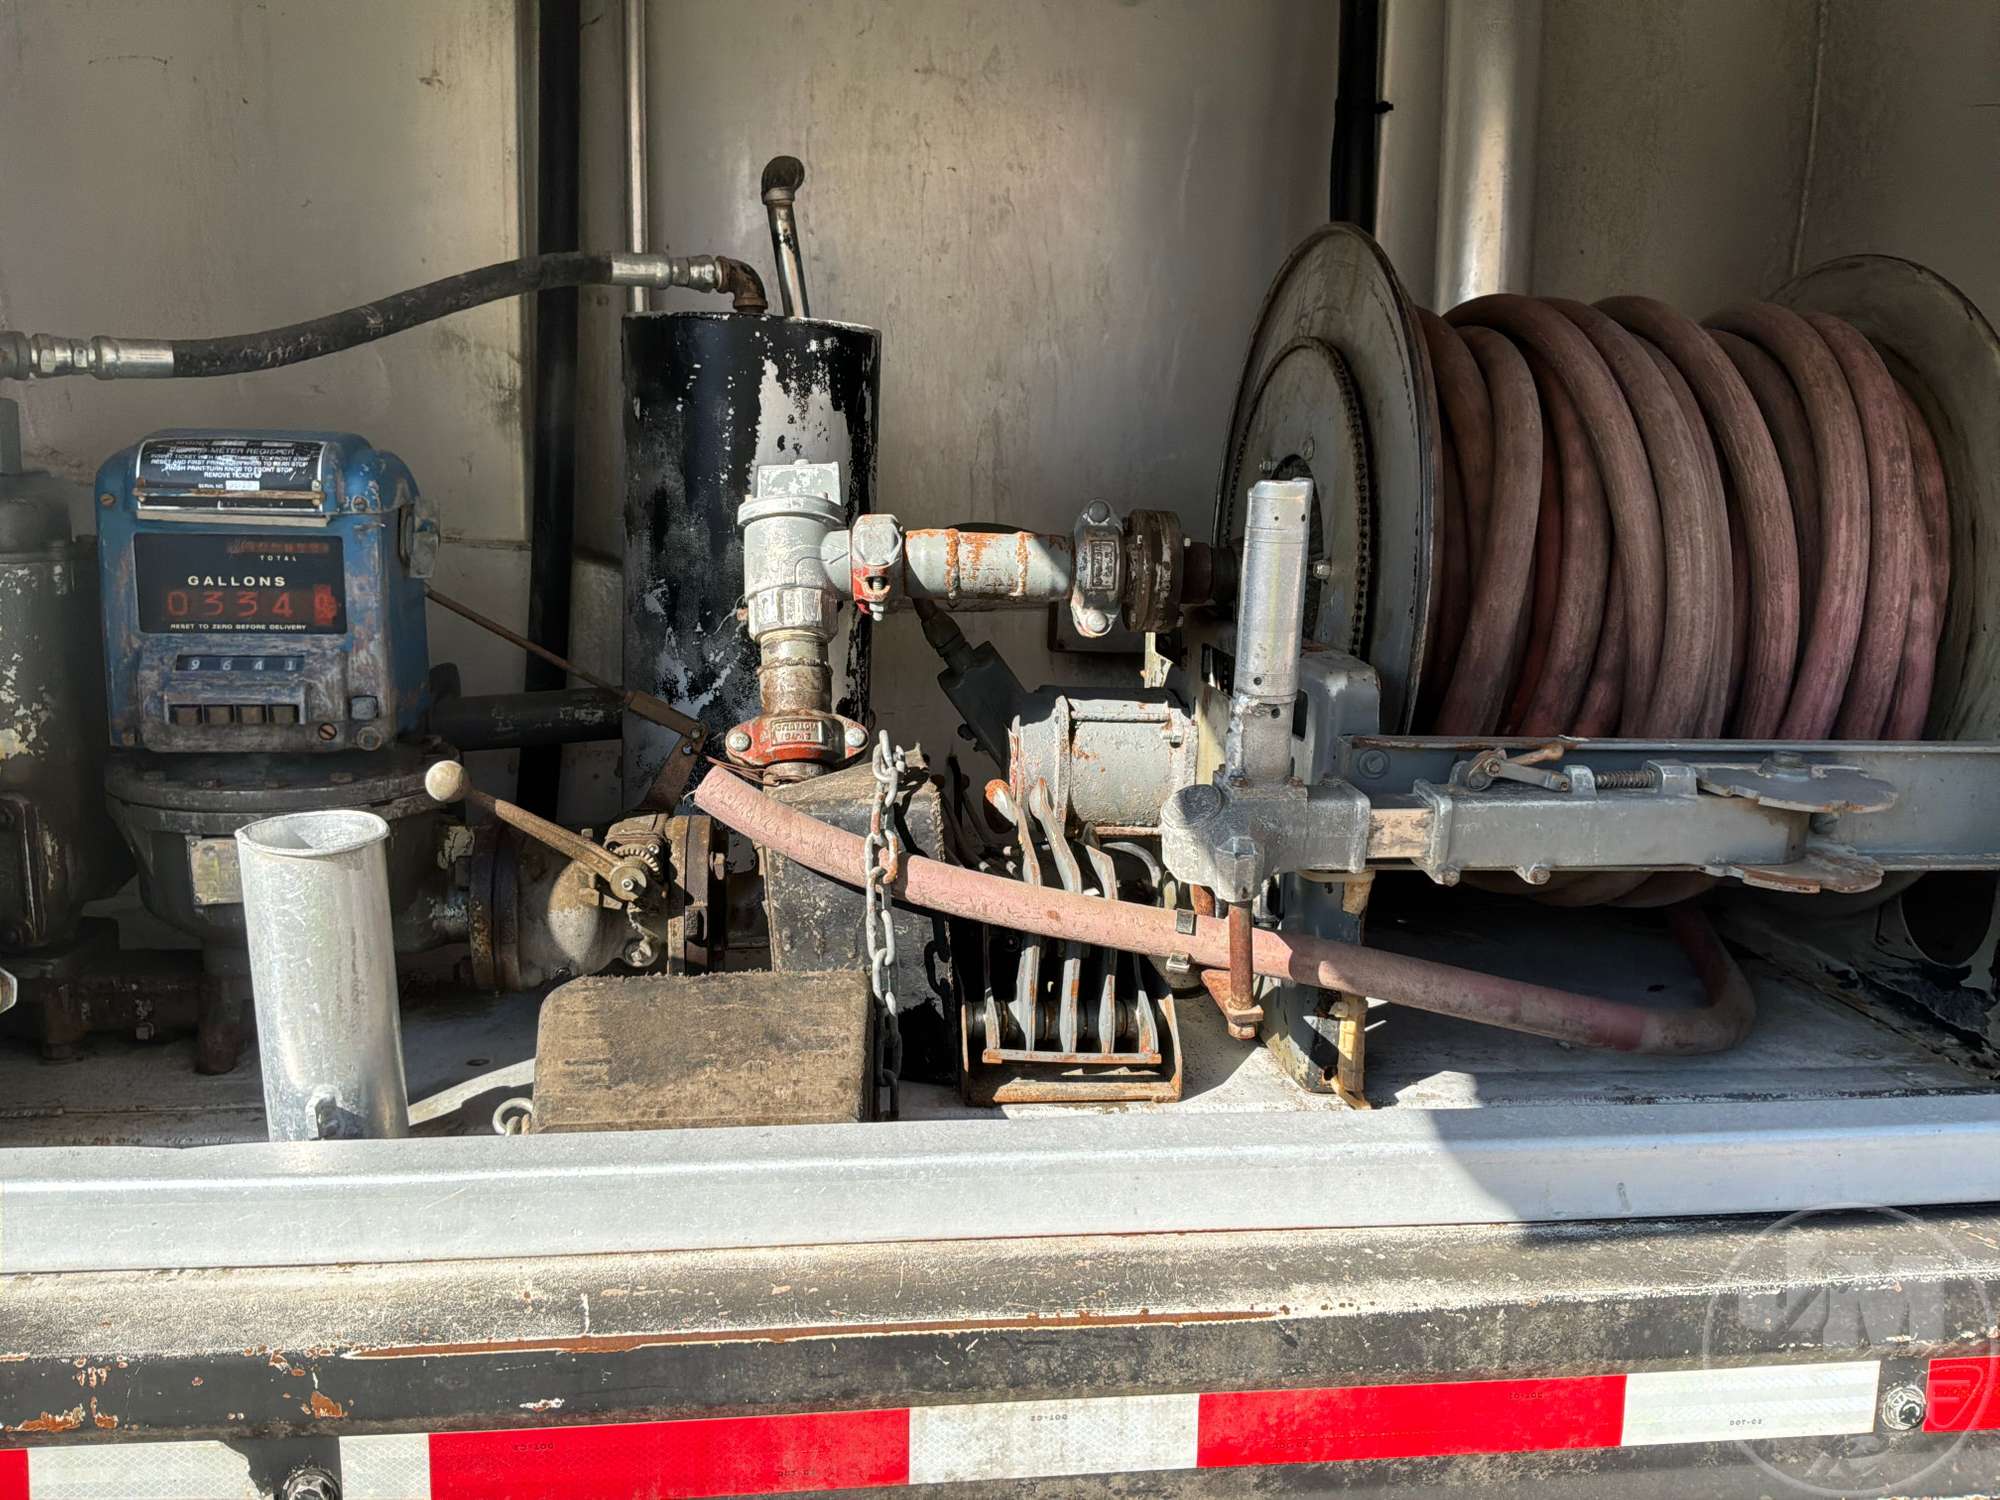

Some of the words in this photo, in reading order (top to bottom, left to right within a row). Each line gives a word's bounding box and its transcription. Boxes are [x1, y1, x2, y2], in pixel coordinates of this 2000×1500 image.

[204, 471, 231, 479] REMOVE
[187, 575, 287, 588] GALLONS
[268, 624, 307, 632] DELIVERY
[1729, 1418, 1763, 1427] DOT-C2
